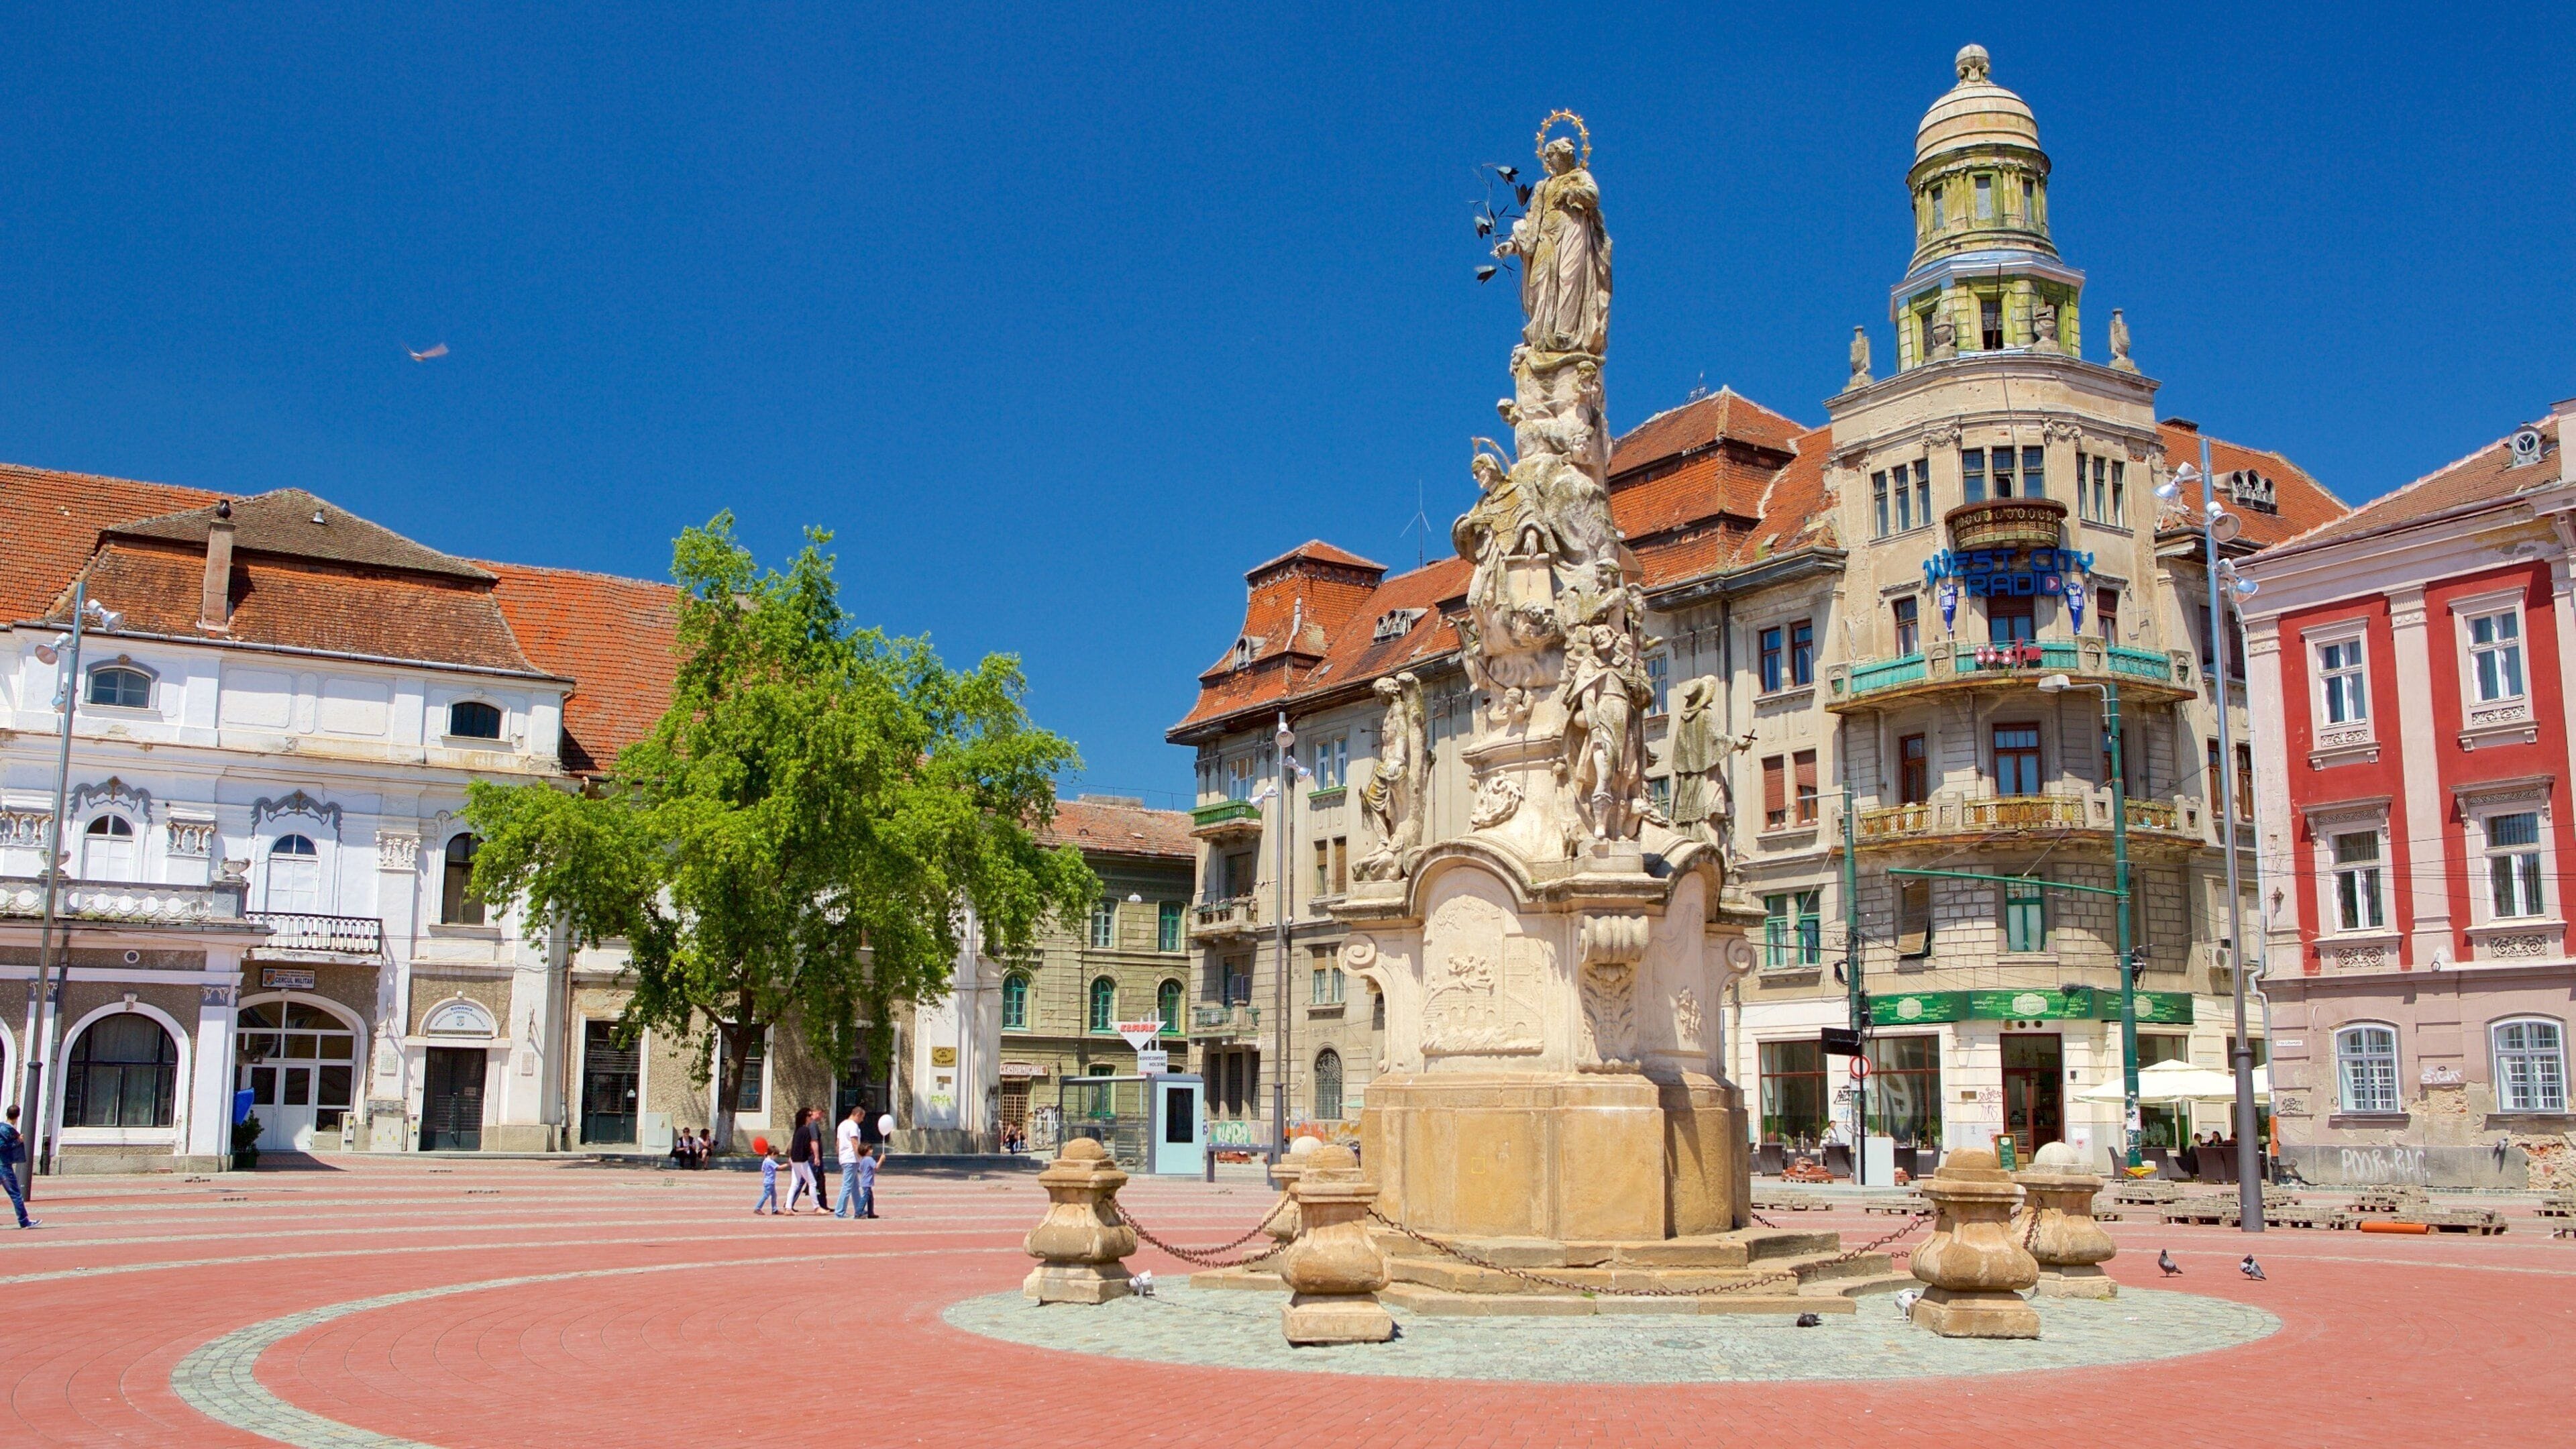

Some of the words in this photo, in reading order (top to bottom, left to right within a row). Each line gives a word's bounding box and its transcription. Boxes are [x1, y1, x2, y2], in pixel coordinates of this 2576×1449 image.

[1923, 548, 2017, 586] WEST
[2030, 549, 2094, 574] CITY
[1966, 572, 2063, 598] RADIO
[1120, 1024, 1157, 1032] CLAAS
